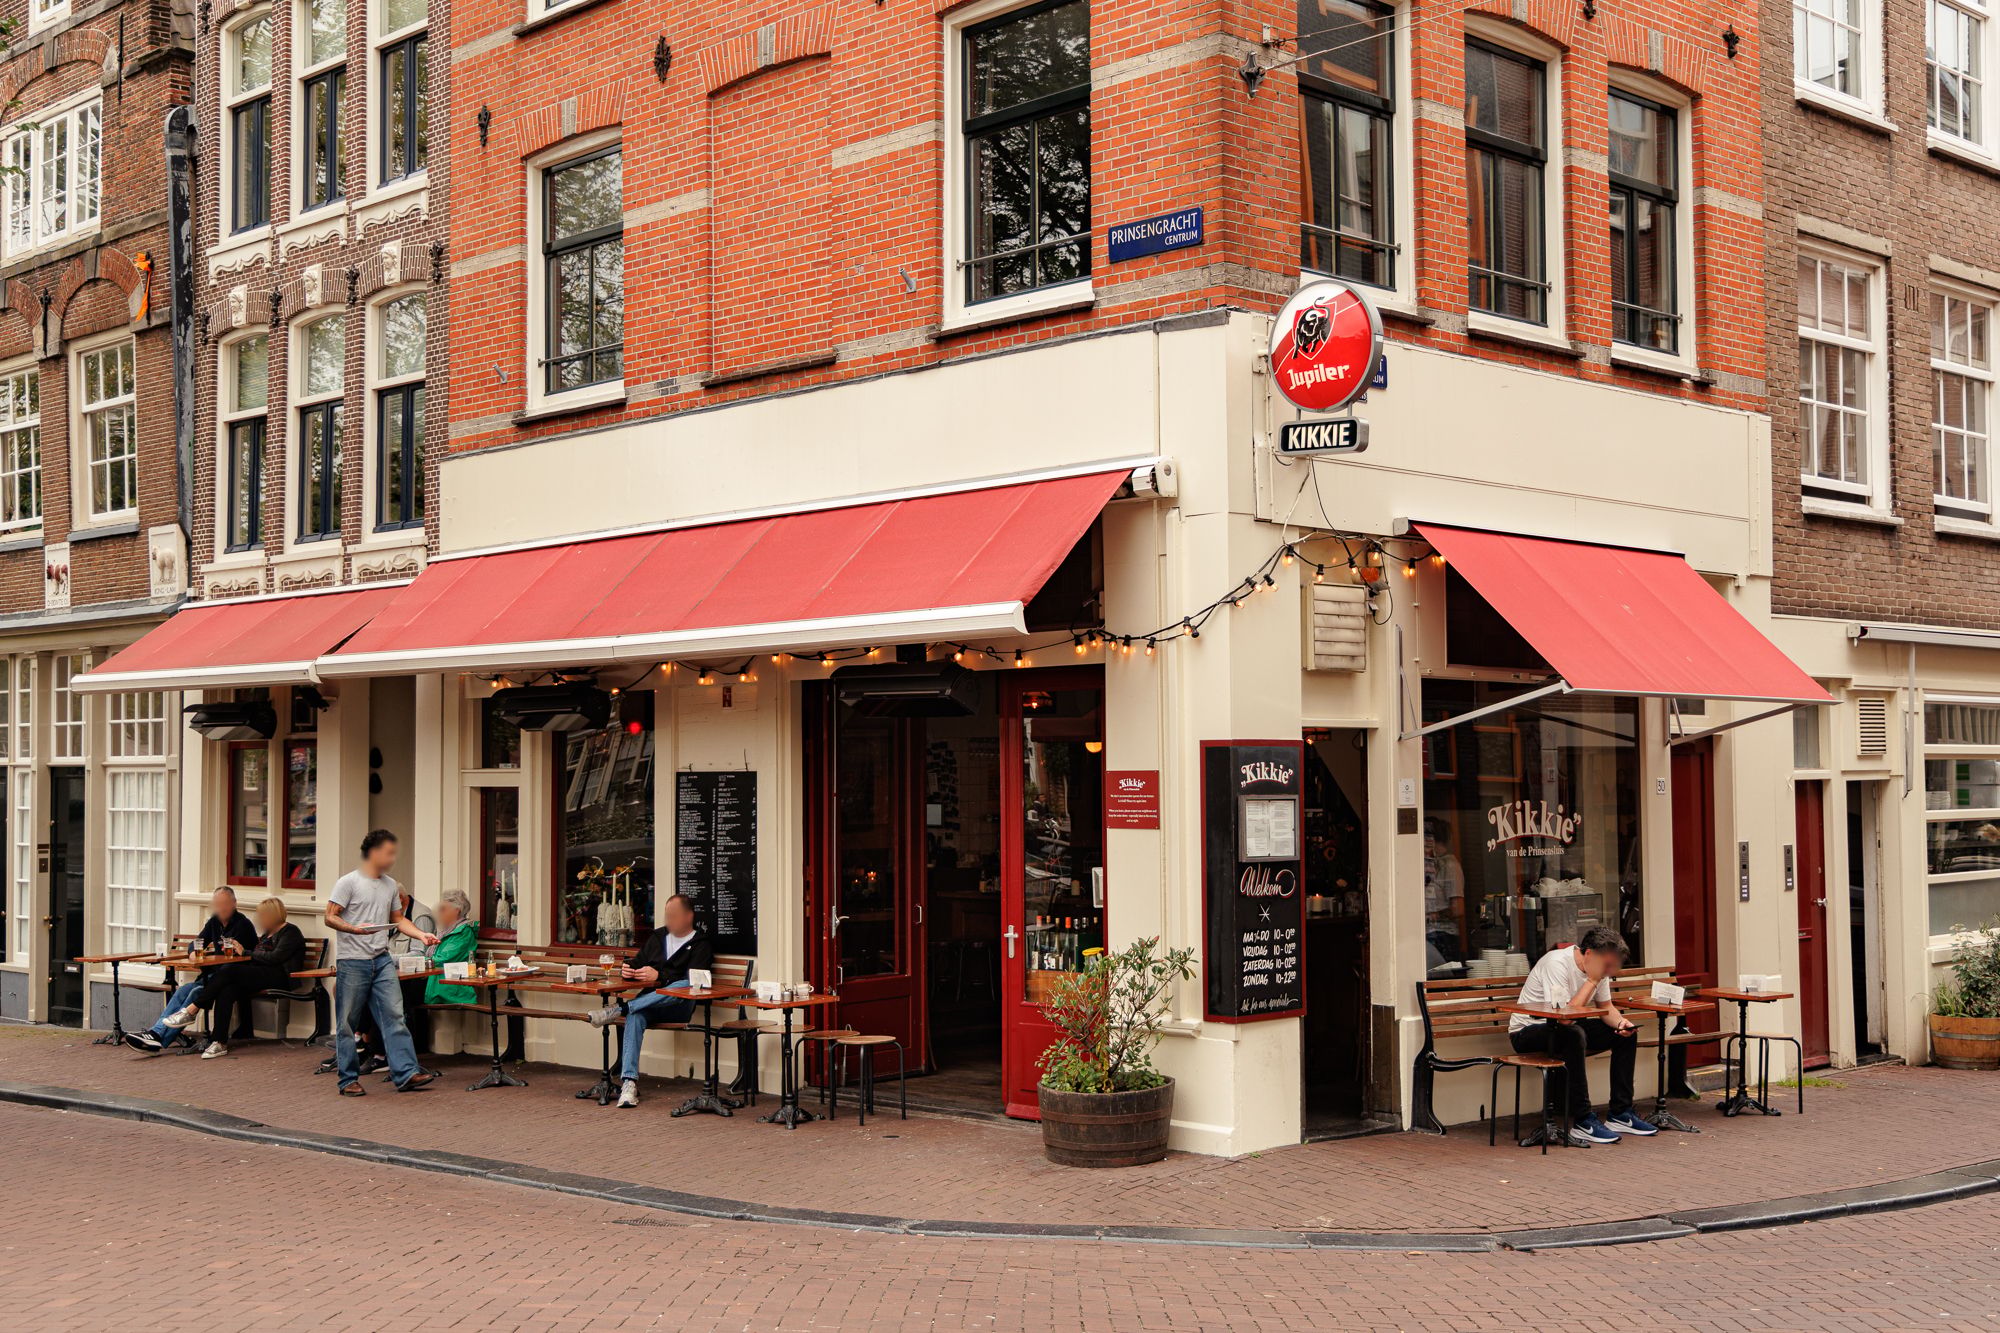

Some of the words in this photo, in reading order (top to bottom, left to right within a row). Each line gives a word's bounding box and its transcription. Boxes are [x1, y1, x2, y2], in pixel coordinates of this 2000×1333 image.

[1111, 212, 1198, 246] PRINSENGRACHT
[1164, 229, 1198, 246] CENTRUM
[1286, 363, 1350, 391] Jupiler
[1288, 423, 1350, 450] KIKKIE
[1506, 848, 1518, 857] van
[1518, 846, 1527, 857] de
[1527, 845, 1565, 857] Prinsensluis
[1240, 863, 1296, 898] Welkom
[1242, 958, 1274, 972] ZATERDAG
[1242, 973, 1269, 987] ZONDAG
